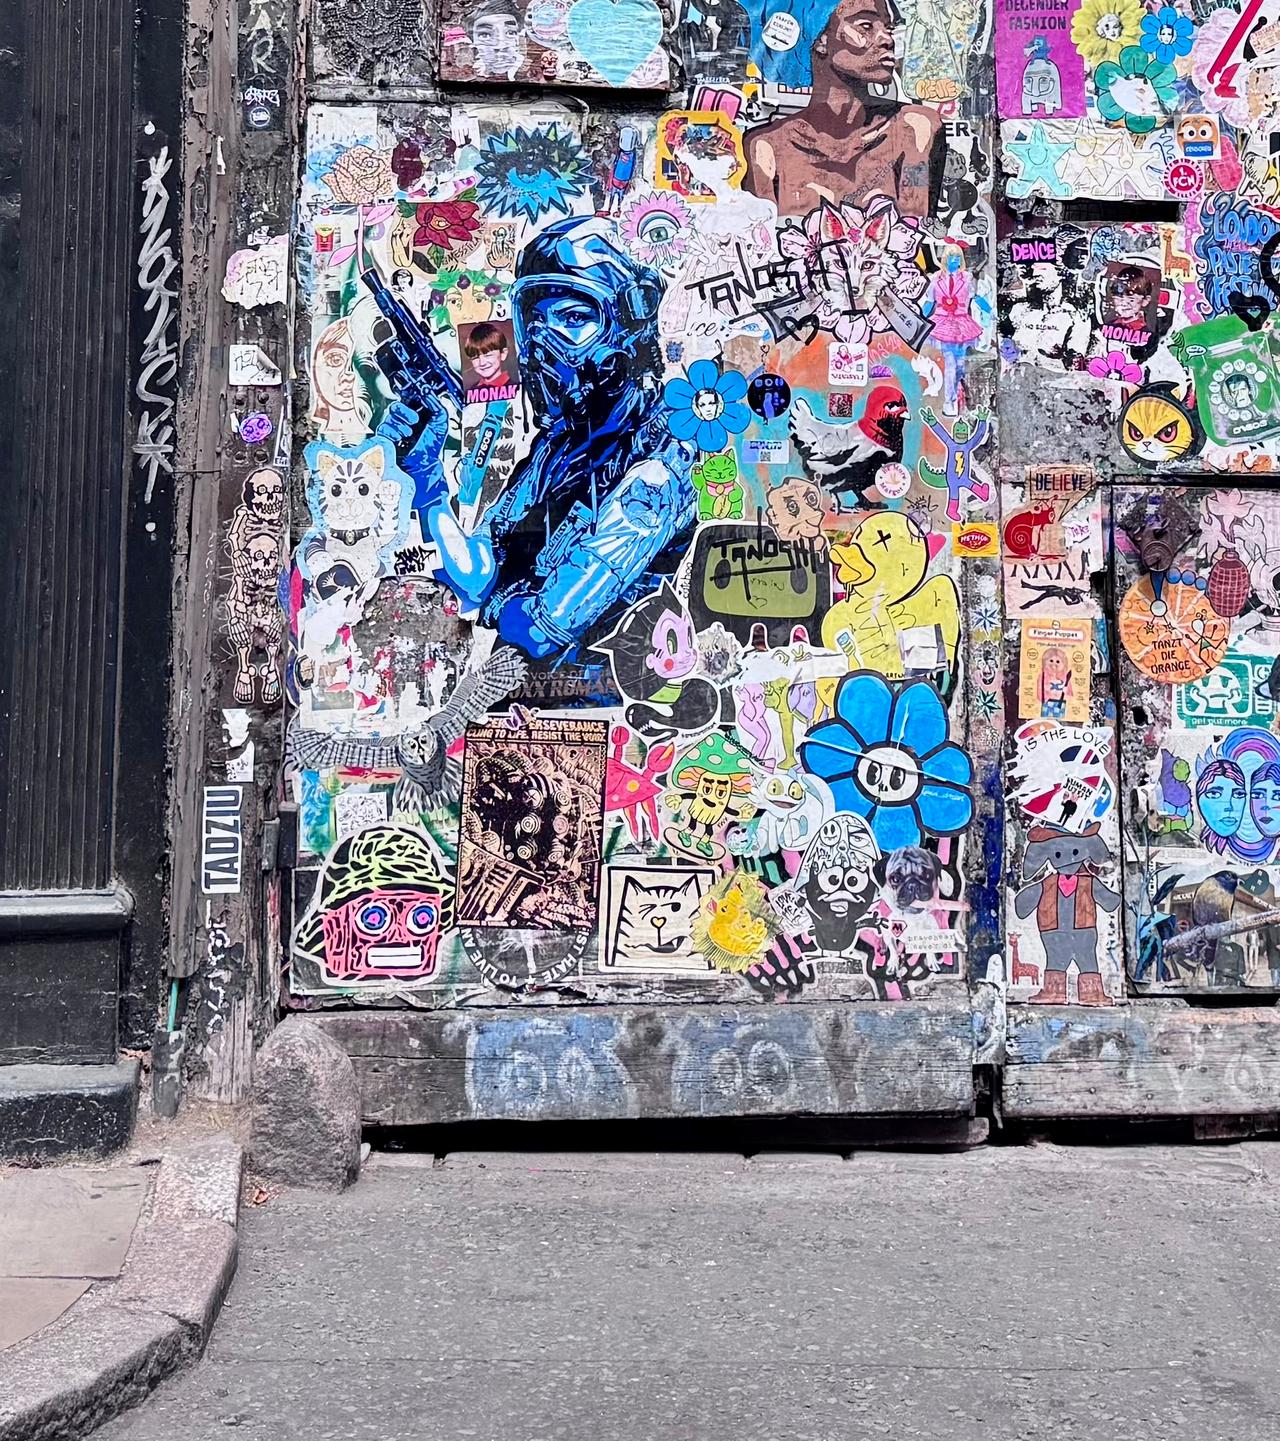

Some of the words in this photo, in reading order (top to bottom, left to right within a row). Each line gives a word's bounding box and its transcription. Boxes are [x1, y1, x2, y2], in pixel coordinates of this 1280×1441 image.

[1008, 16, 1067, 31] FASHION
[1172, 175, 1196, 187] FCN
[1011, 240, 1056, 262] DENCE
[1035, 473, 1087, 491] BELIEVE
[1151, 638, 1184, 651] TANZT
[1160, 650, 1178, 661] DIE
[1150, 660, 1192, 675] ORANGE
[528, 718, 607, 733] ERSEVERANCE
[531, 730, 563, 741] RESIST
[1040, 728, 1068, 744] THE
[1073, 729, 1110, 756] LOVE
[204, 788, 241, 890] TADZIU
[540, 951, 578, 984] HATE
